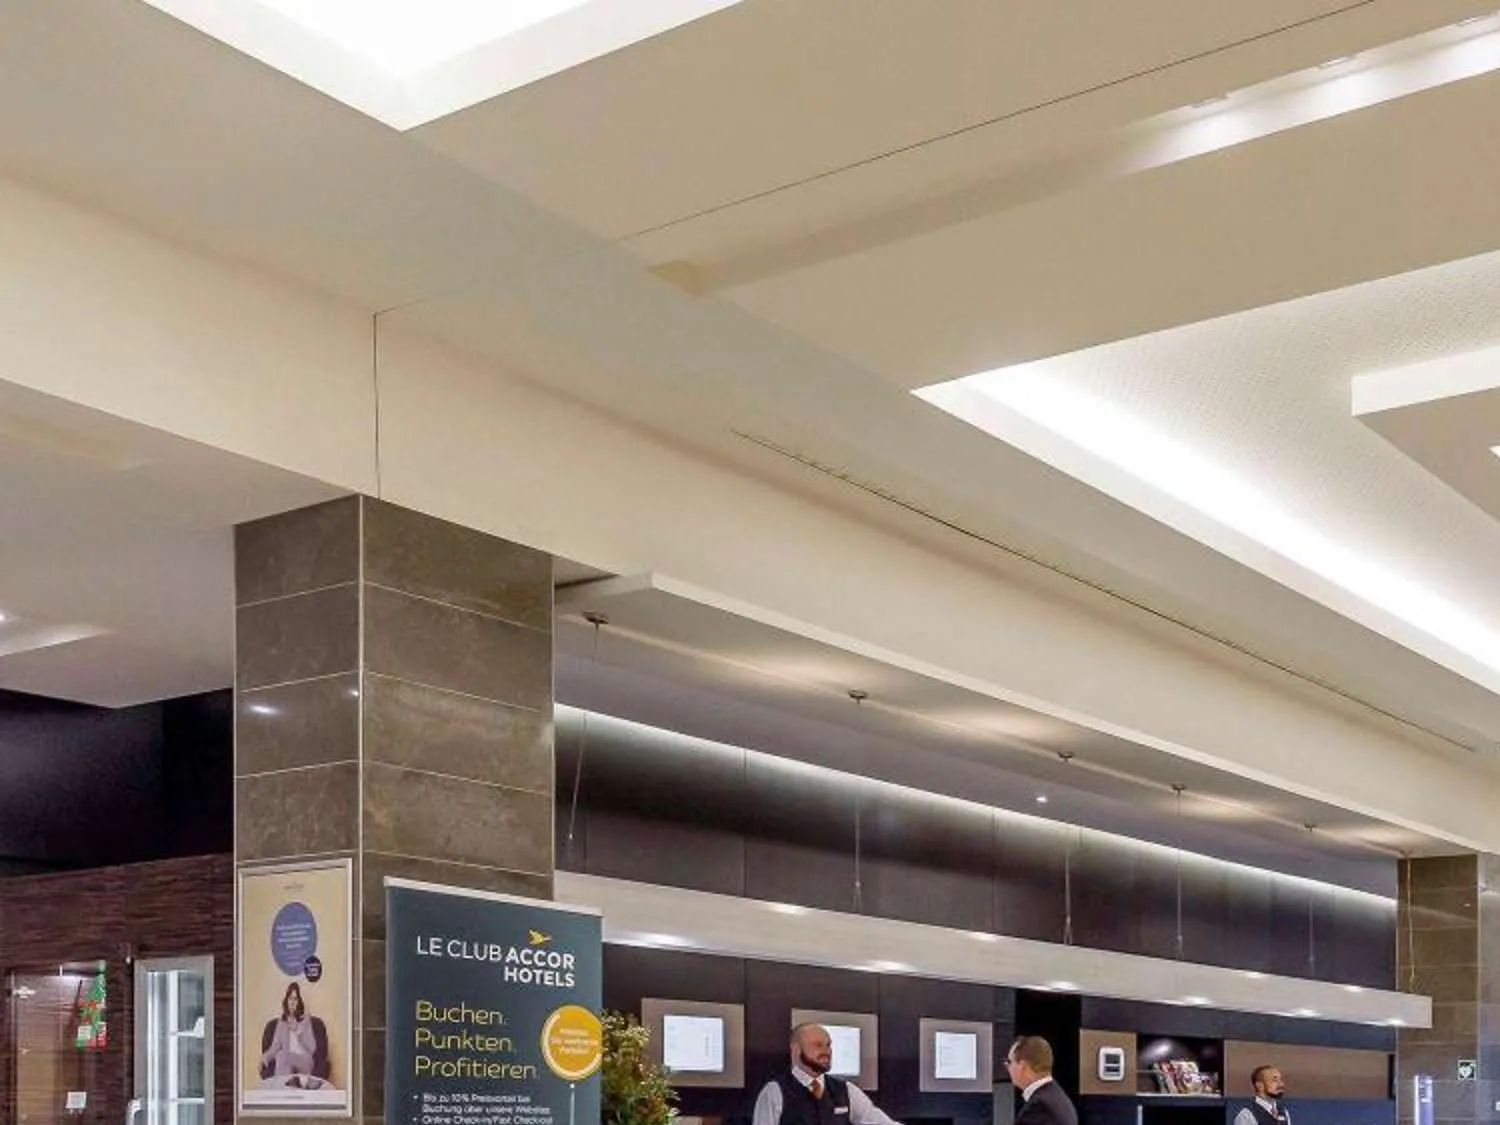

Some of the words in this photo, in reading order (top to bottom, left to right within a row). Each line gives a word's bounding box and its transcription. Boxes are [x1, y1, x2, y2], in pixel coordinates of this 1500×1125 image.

[416, 935, 443, 956] LE
[447, 939, 502, 961] CLUB
[505, 947, 575, 970] ACCOR
[503, 967, 575, 987] HOTELS
